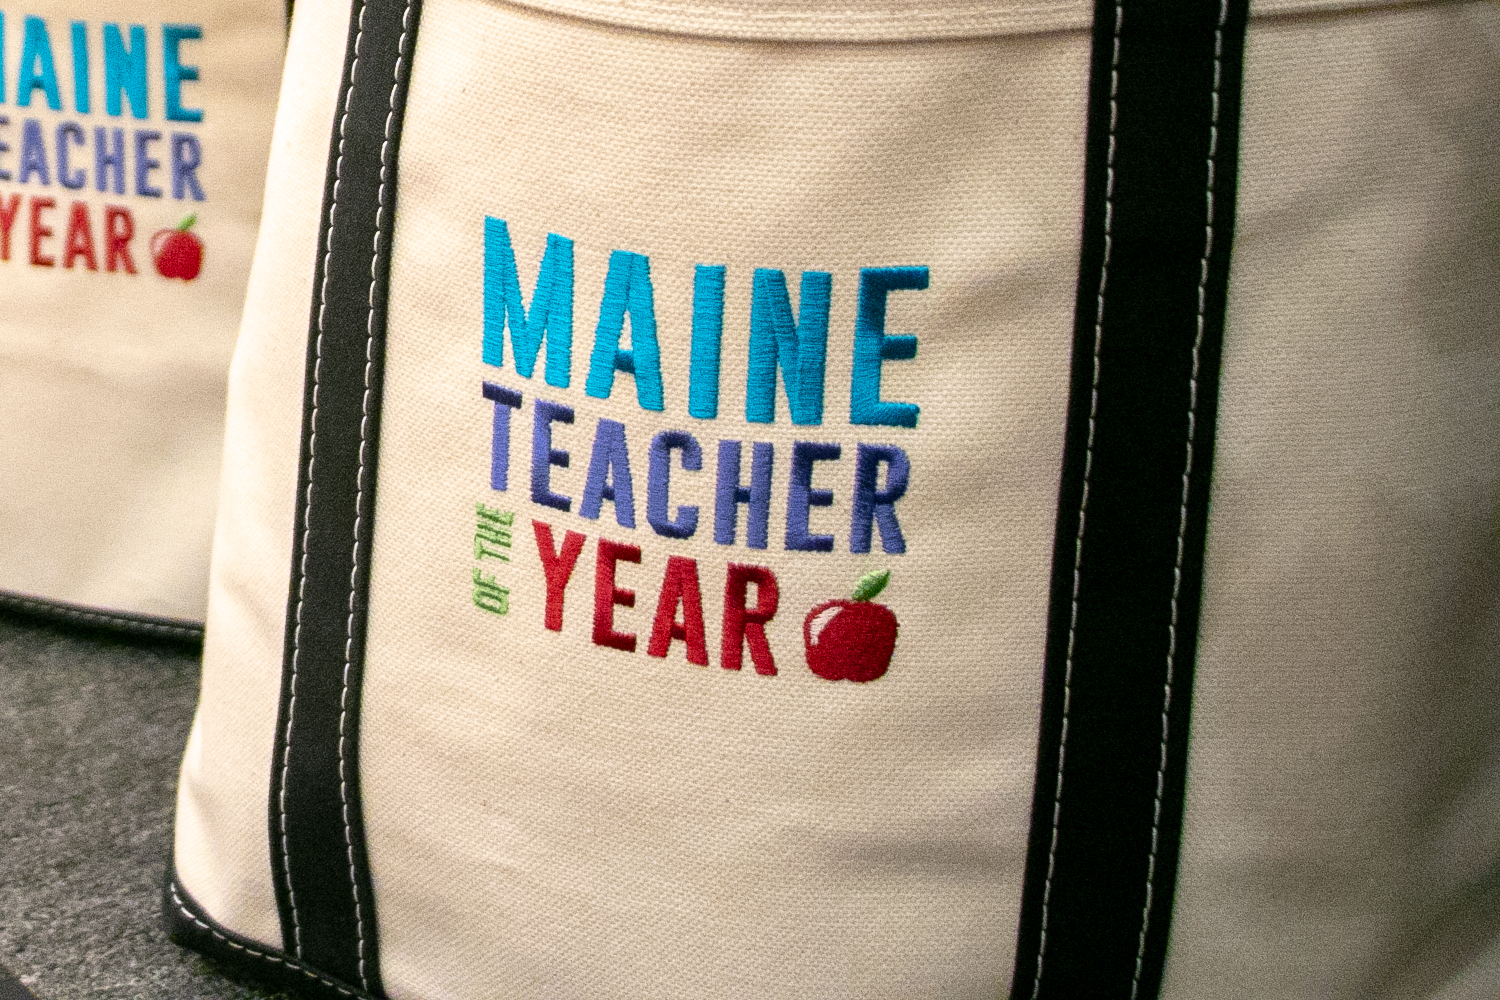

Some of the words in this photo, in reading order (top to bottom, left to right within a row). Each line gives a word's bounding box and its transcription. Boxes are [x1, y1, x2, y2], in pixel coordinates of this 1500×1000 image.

[482, 215, 930, 428] MAINE
[473, 502, 515, 562] THE
[482, 380, 911, 555] TEACHER
[472, 566, 509, 617] OF
[532, 519, 779, 676] YEAR
